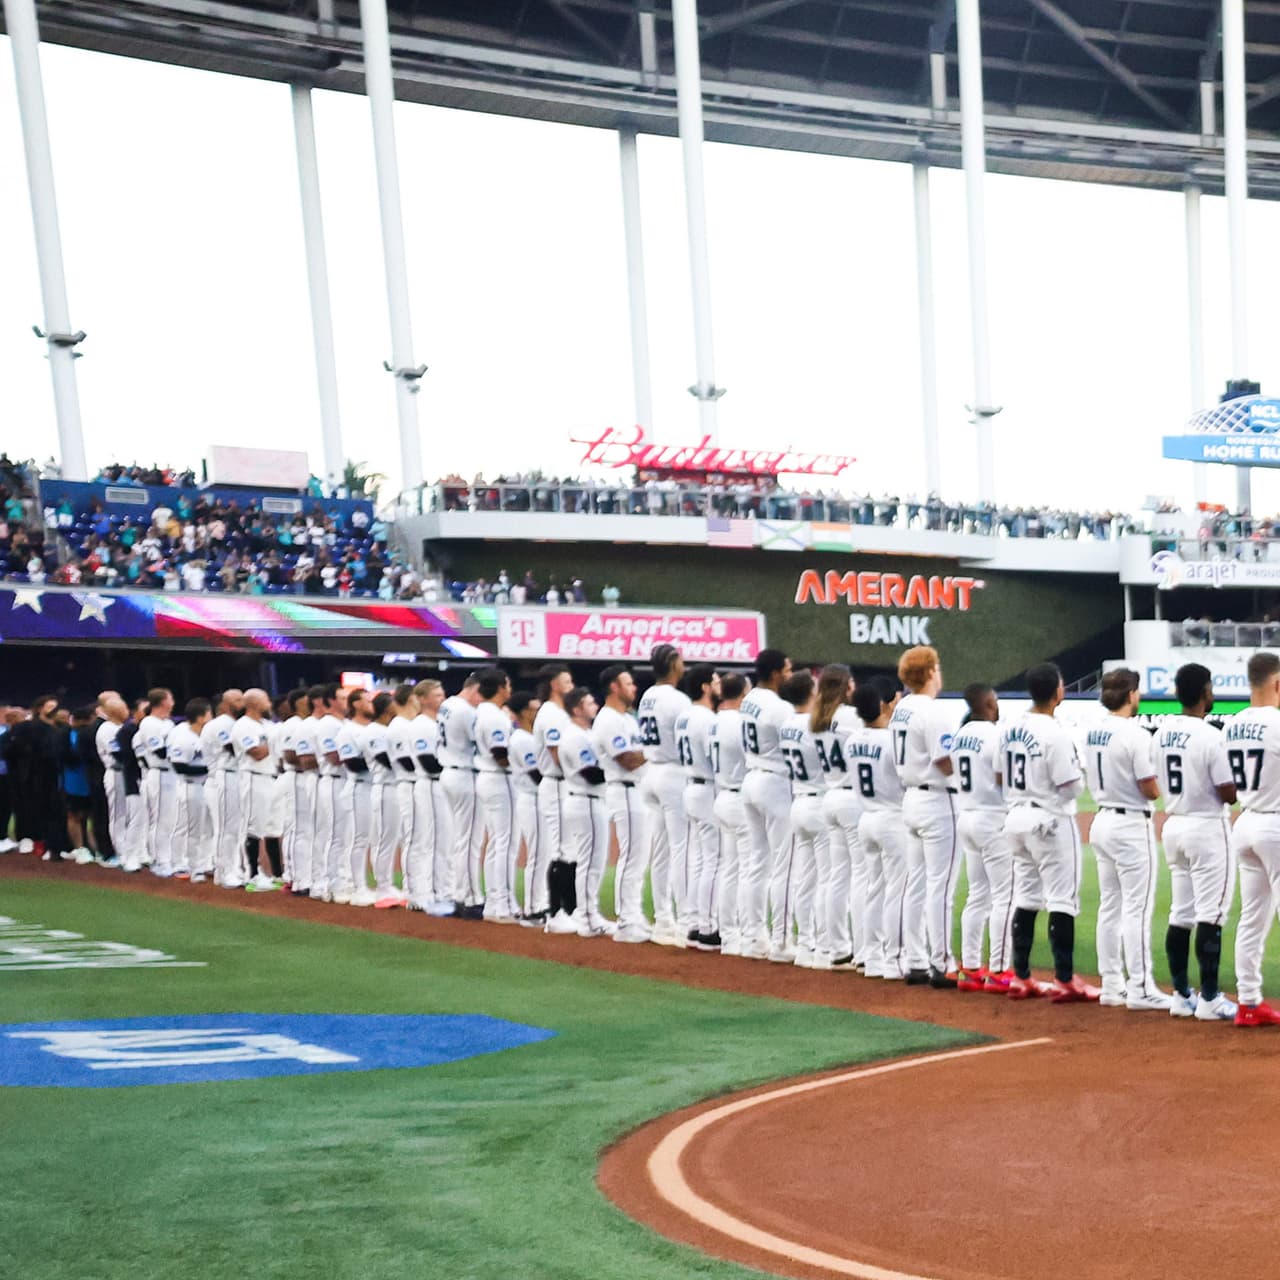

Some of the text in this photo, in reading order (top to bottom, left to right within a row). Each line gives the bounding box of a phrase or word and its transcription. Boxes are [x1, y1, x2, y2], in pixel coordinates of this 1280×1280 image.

[1203, 445, 1255, 459] HOME
[1186, 561, 1238, 584] arajet
[794, 568, 976, 611] AMERANT
[580, 615, 728, 638] America's
[849, 612, 932, 645] BANK
[557, 634, 626, 657] Best
[1160, 732, 1191, 749] LOPEZ
[1225, 723, 1267, 742] MARSEE
[858, 763, 875, 798] 8
[958, 755, 972, 793] 9
[1006, 750, 1027, 791] 13
[1166, 754, 1183, 795] 6
[1227, 748, 1265, 792] 87
